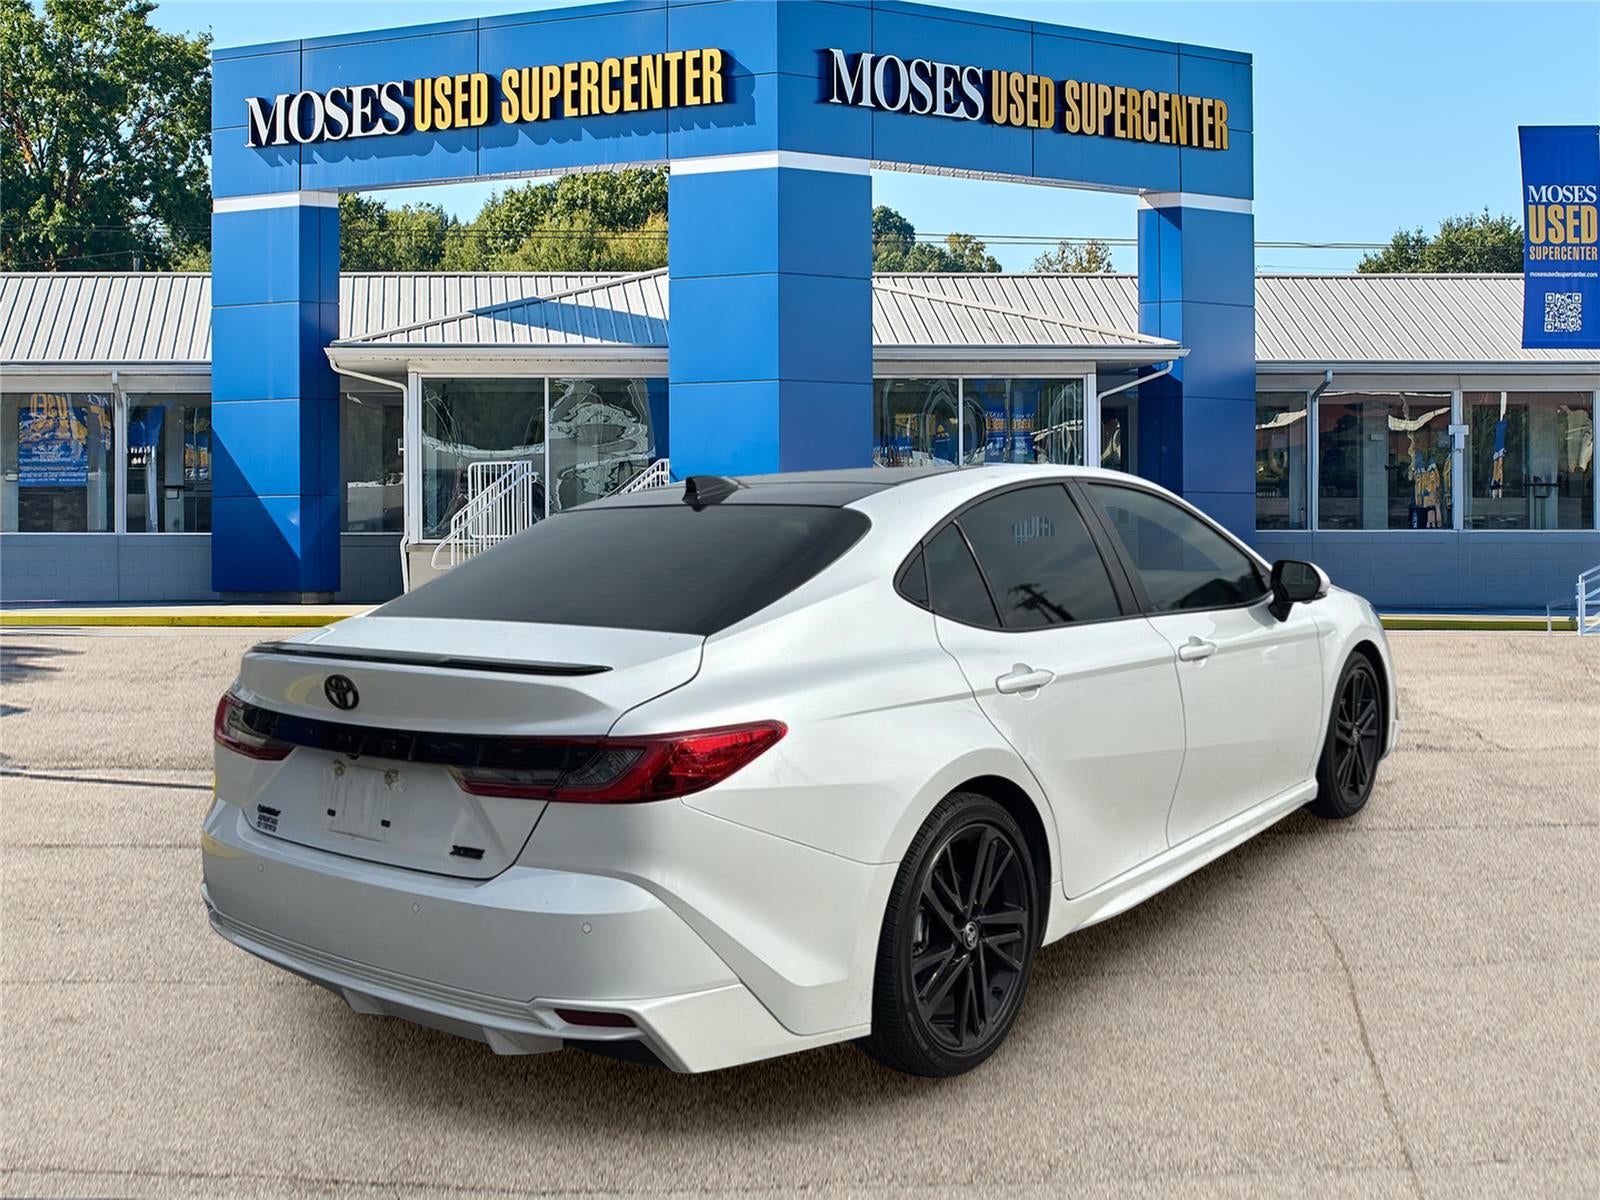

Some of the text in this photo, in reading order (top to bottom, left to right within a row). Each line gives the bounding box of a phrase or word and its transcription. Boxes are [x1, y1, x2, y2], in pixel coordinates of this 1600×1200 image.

[244, 47, 724, 148] MOSES USED SUPERCENTER
[828, 48, 1230, 151] MOSES USED SUPERCENTER
[1528, 185, 1597, 203] MOSES
[1528, 205, 1598, 244] USED
[1529, 246, 1598, 261] SUPERCENTER
